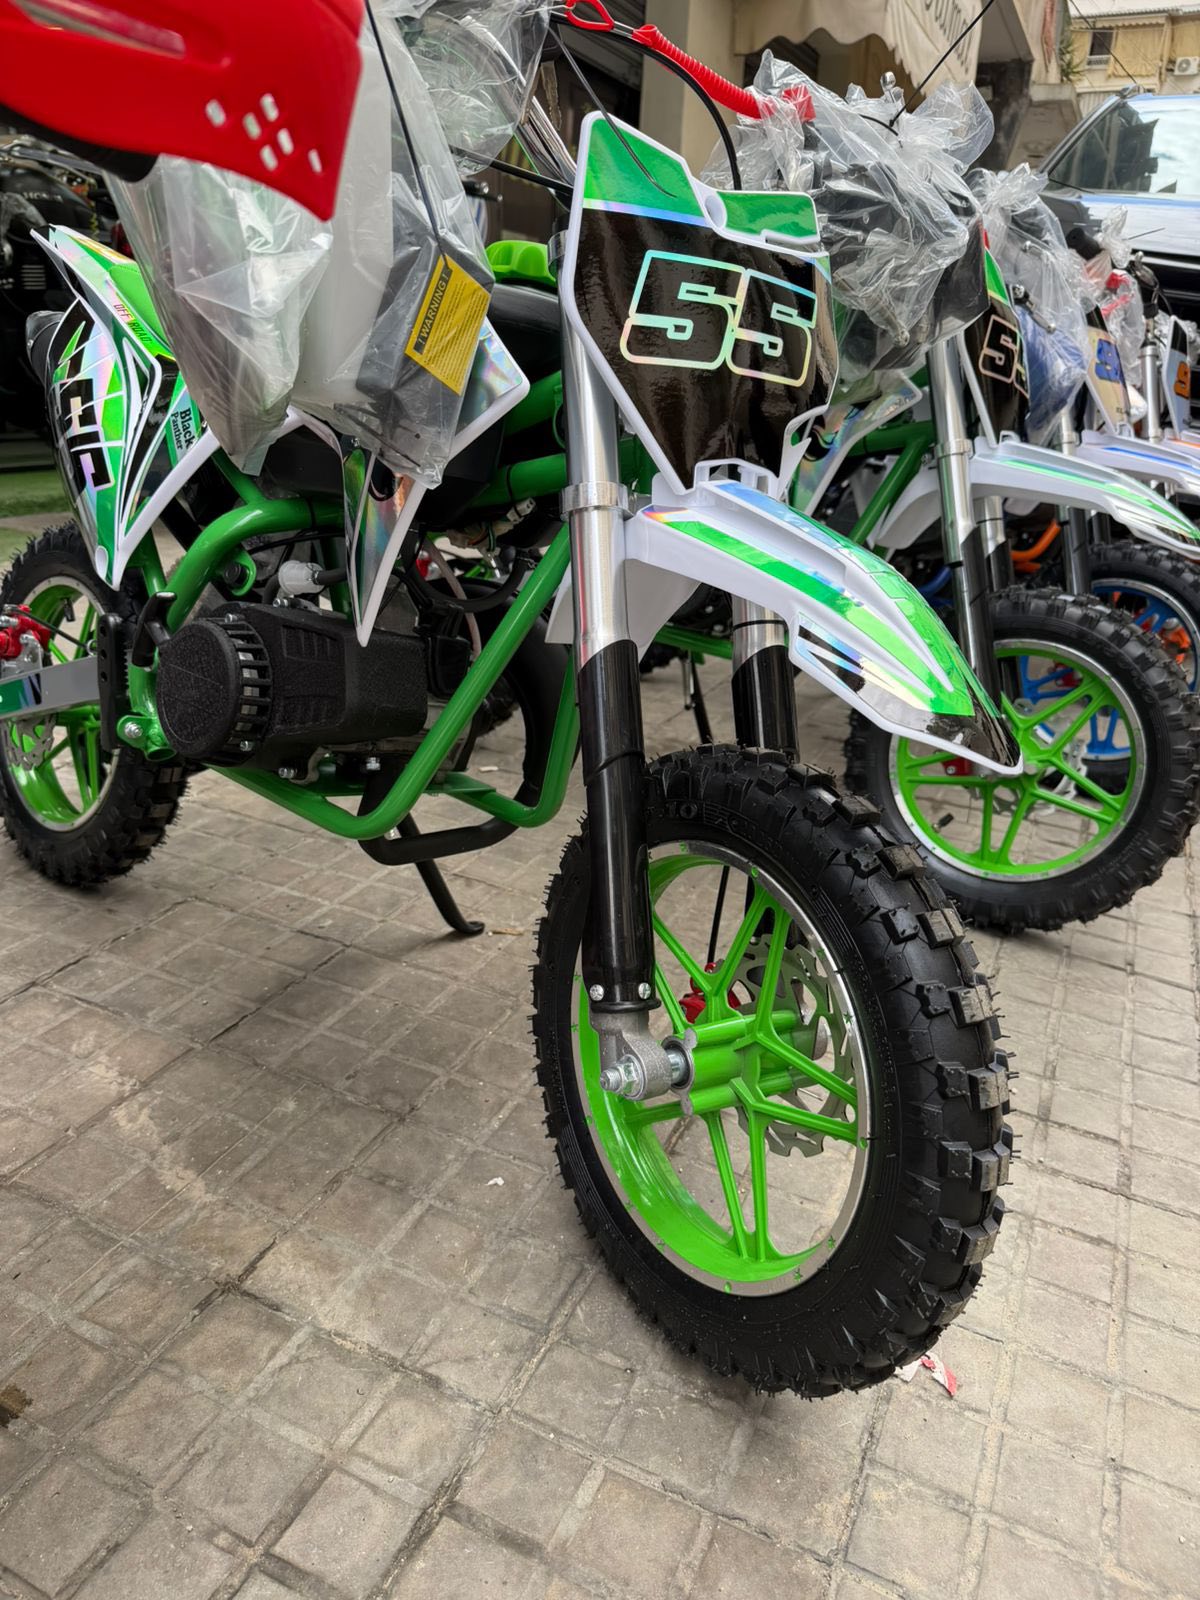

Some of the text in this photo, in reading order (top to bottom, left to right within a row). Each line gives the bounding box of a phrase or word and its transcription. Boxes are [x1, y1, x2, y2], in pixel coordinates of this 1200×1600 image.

[113, 303, 153, 343] OFF ROAD
[420, 280, 448, 339] WARNING
[620, 249, 818, 387] 55
[979, 314, 1030, 399] 5
[171, 411, 184, 450] Panther
[180, 407, 196, 450] Black
